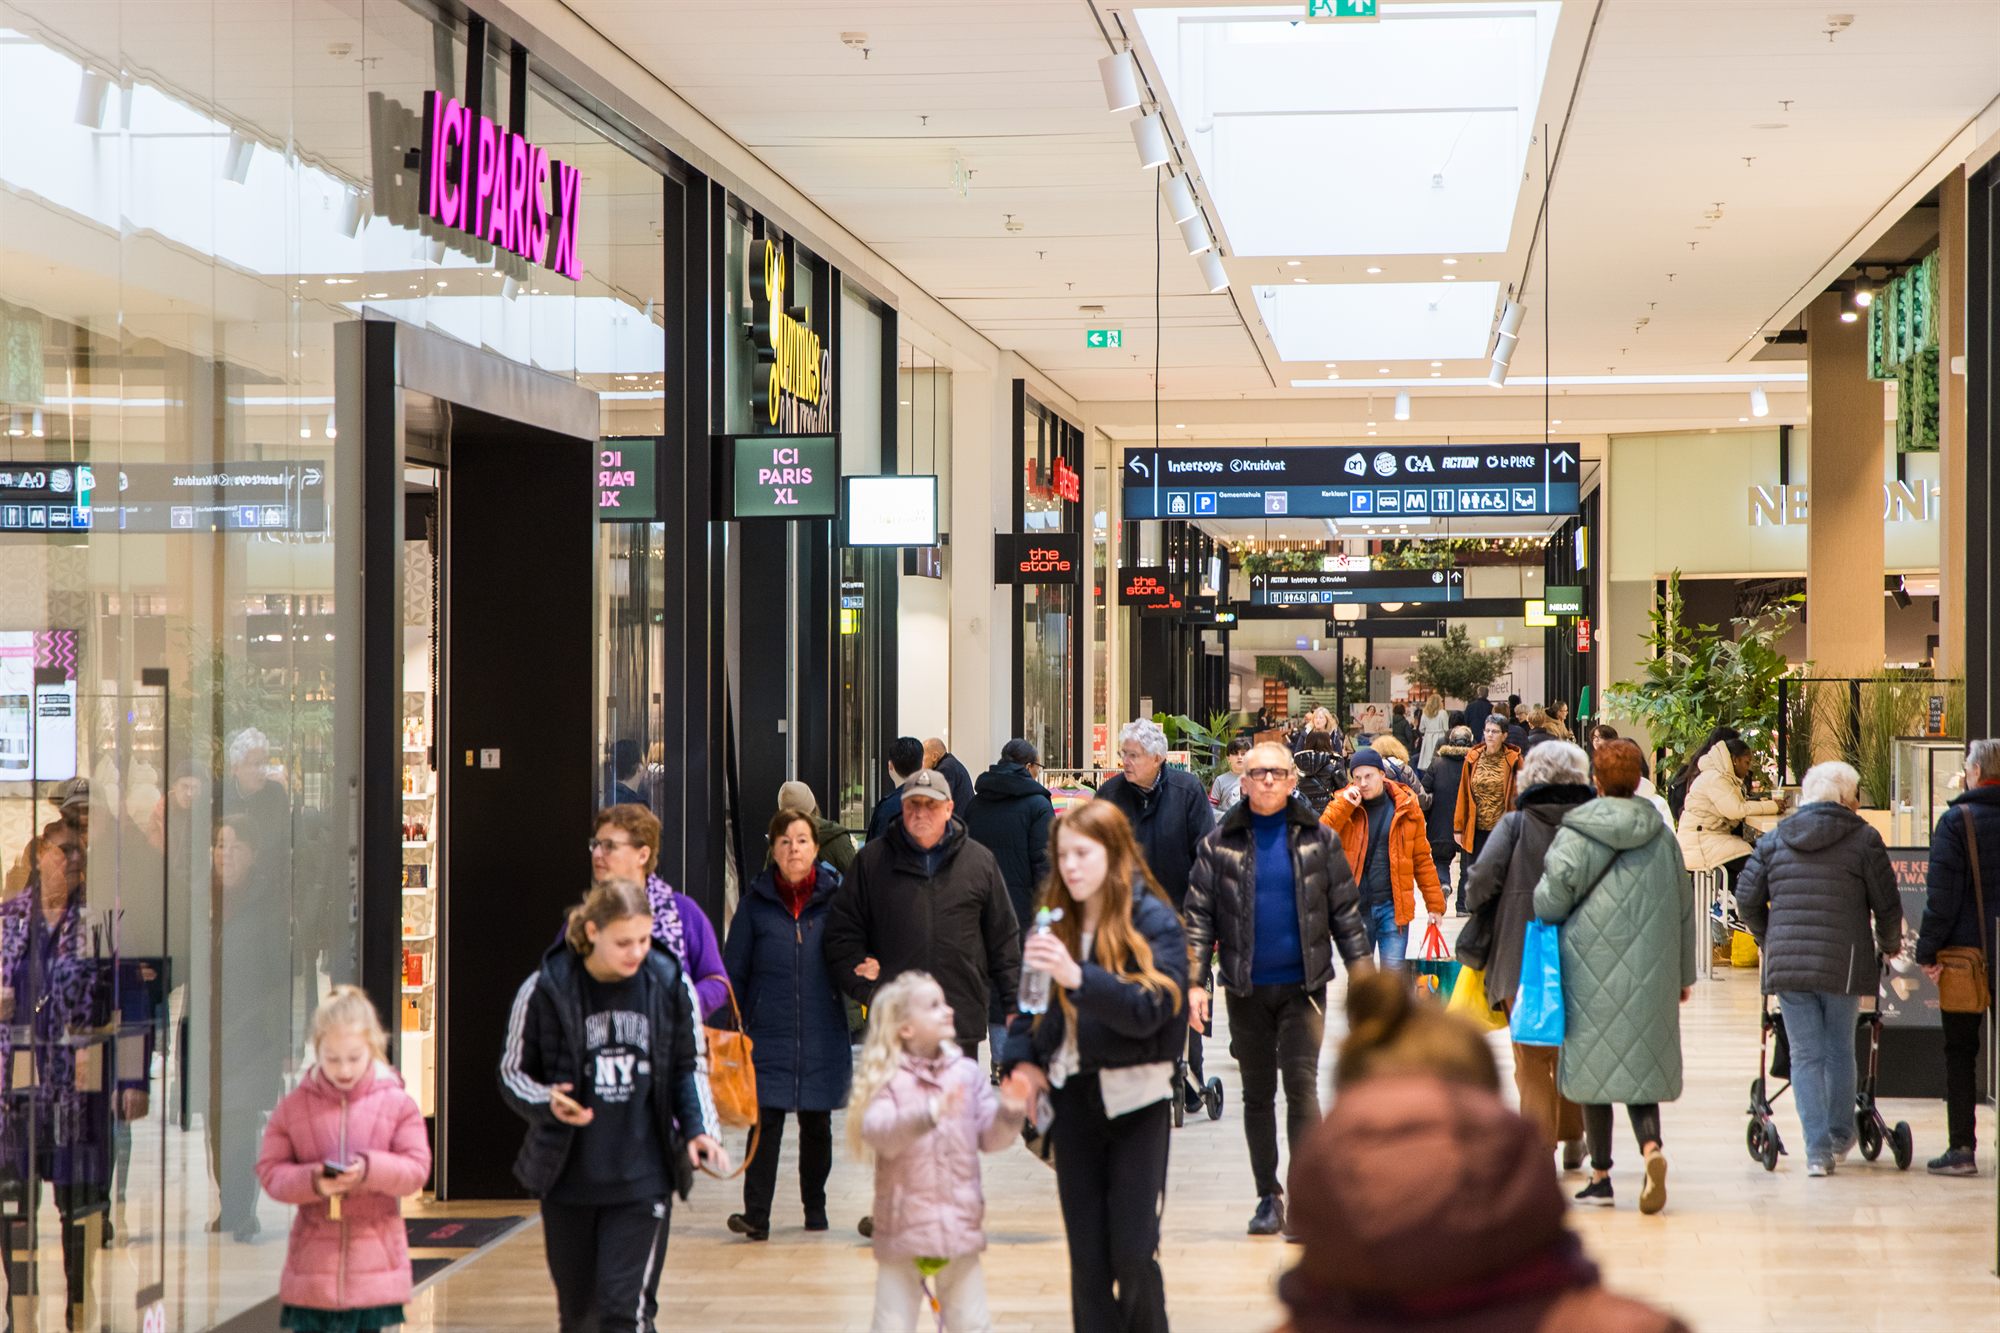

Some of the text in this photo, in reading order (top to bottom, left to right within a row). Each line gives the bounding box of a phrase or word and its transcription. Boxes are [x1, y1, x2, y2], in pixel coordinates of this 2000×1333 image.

[428, 89, 583, 282] ICI PARIS XL
[773, 447, 799, 465] ICI
[1442, 456, 1480, 469] ACTION
[1509, 455, 1536, 468] PLACE
[1167, 459, 1286, 474] Intertoys Kruidvat
[1404, 454, 1436, 473] C&A
[758, 467, 813, 486] PARIS
[773, 488, 799, 505] XL
[1271, 500, 1280, 511] 6
[1029, 547, 1060, 561] the
[1020, 559, 1071, 572] stone
[1133, 575, 1157, 587] the
[1126, 585, 1166, 596] stone
[1548, 603, 1579, 612] NELSON
[1911, 860, 1929, 873] KE
[1904, 872, 1926, 884] WA
[595, 1053, 636, 1086] NY
